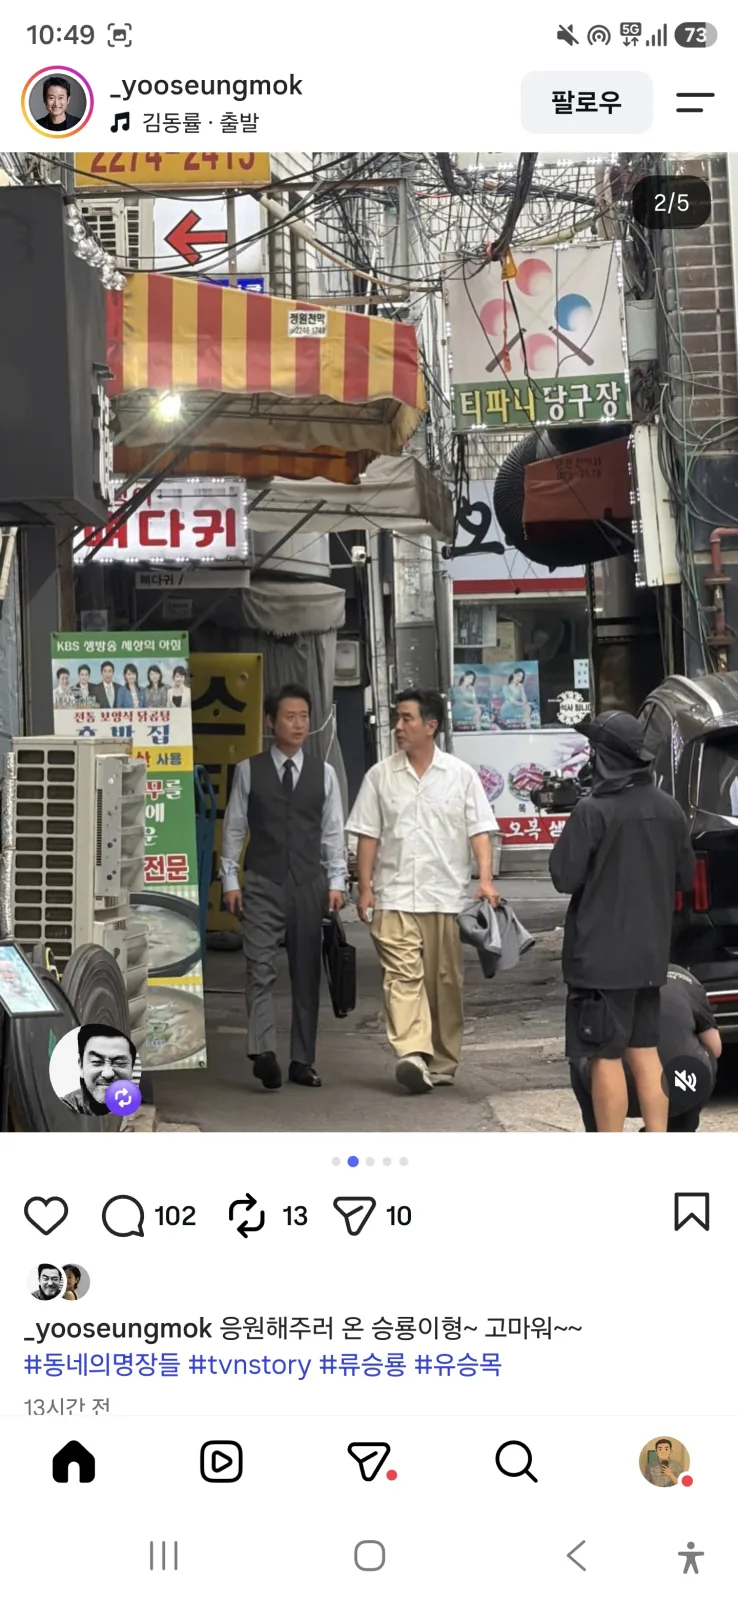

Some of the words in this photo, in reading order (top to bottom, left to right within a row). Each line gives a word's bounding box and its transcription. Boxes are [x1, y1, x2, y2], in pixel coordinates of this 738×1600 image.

[458, 388, 536, 424] 티파니
[543, 381, 622, 421] 당구장
[56, 641, 80, 652] KBS
[84, 640, 117, 652] 생방송
[121, 639, 155, 652] 세상의
[159, 639, 182, 652] 아침
[73, 711, 96, 723] 전통
[100, 710, 133, 723] 보양식
[156, 752, 182, 766] 사용
[505, 818, 542, 841] 오복
[144, 853, 189, 883] 전문
